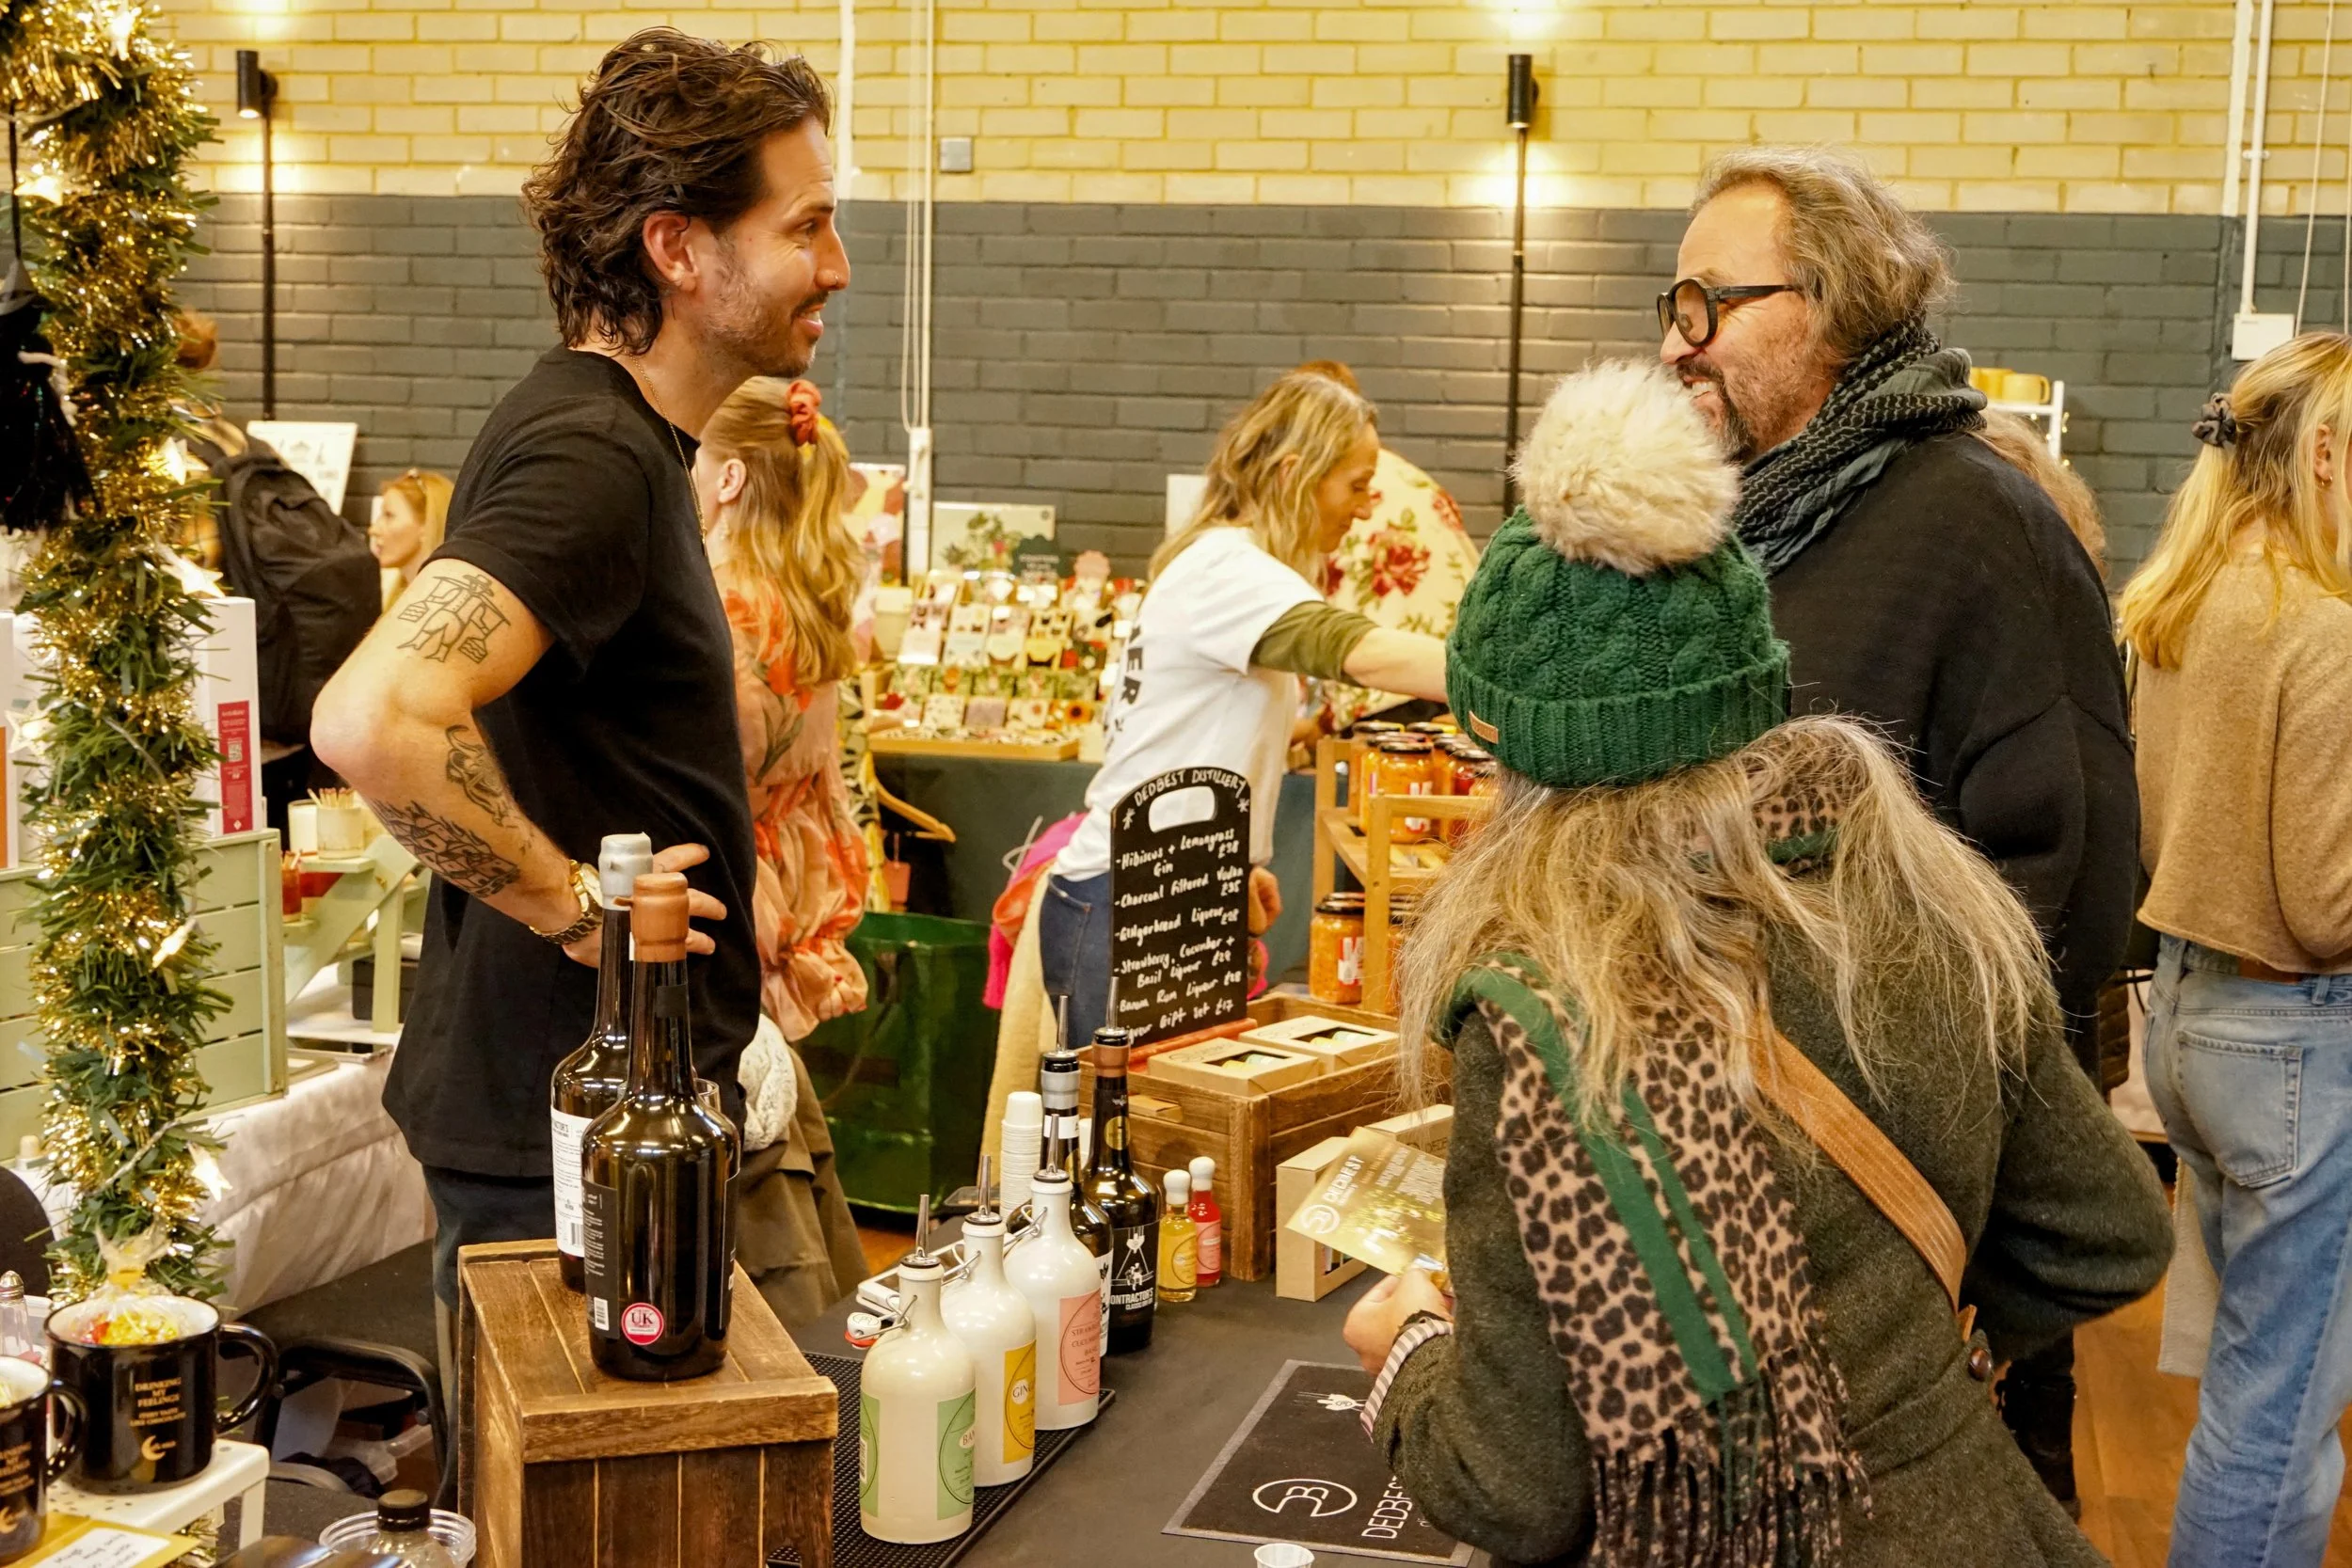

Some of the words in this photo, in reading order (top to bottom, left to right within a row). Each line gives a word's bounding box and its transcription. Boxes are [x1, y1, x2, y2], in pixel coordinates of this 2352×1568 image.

[1134, 770, 1185, 807] DEDBEST
[1192, 769, 1247, 799] DISTILLERY
[1180, 828, 1235, 852] Lemongrass
[1153, 859, 1174, 878] Gin
[1136, 969, 1163, 989] Basil
[1159, 1006, 1187, 1029] Gift
[1215, 998, 1234, 1016] £17
[1109, 1287, 1153, 1306] ONTRACTOR'S
[631, 1312, 654, 1325] UK
